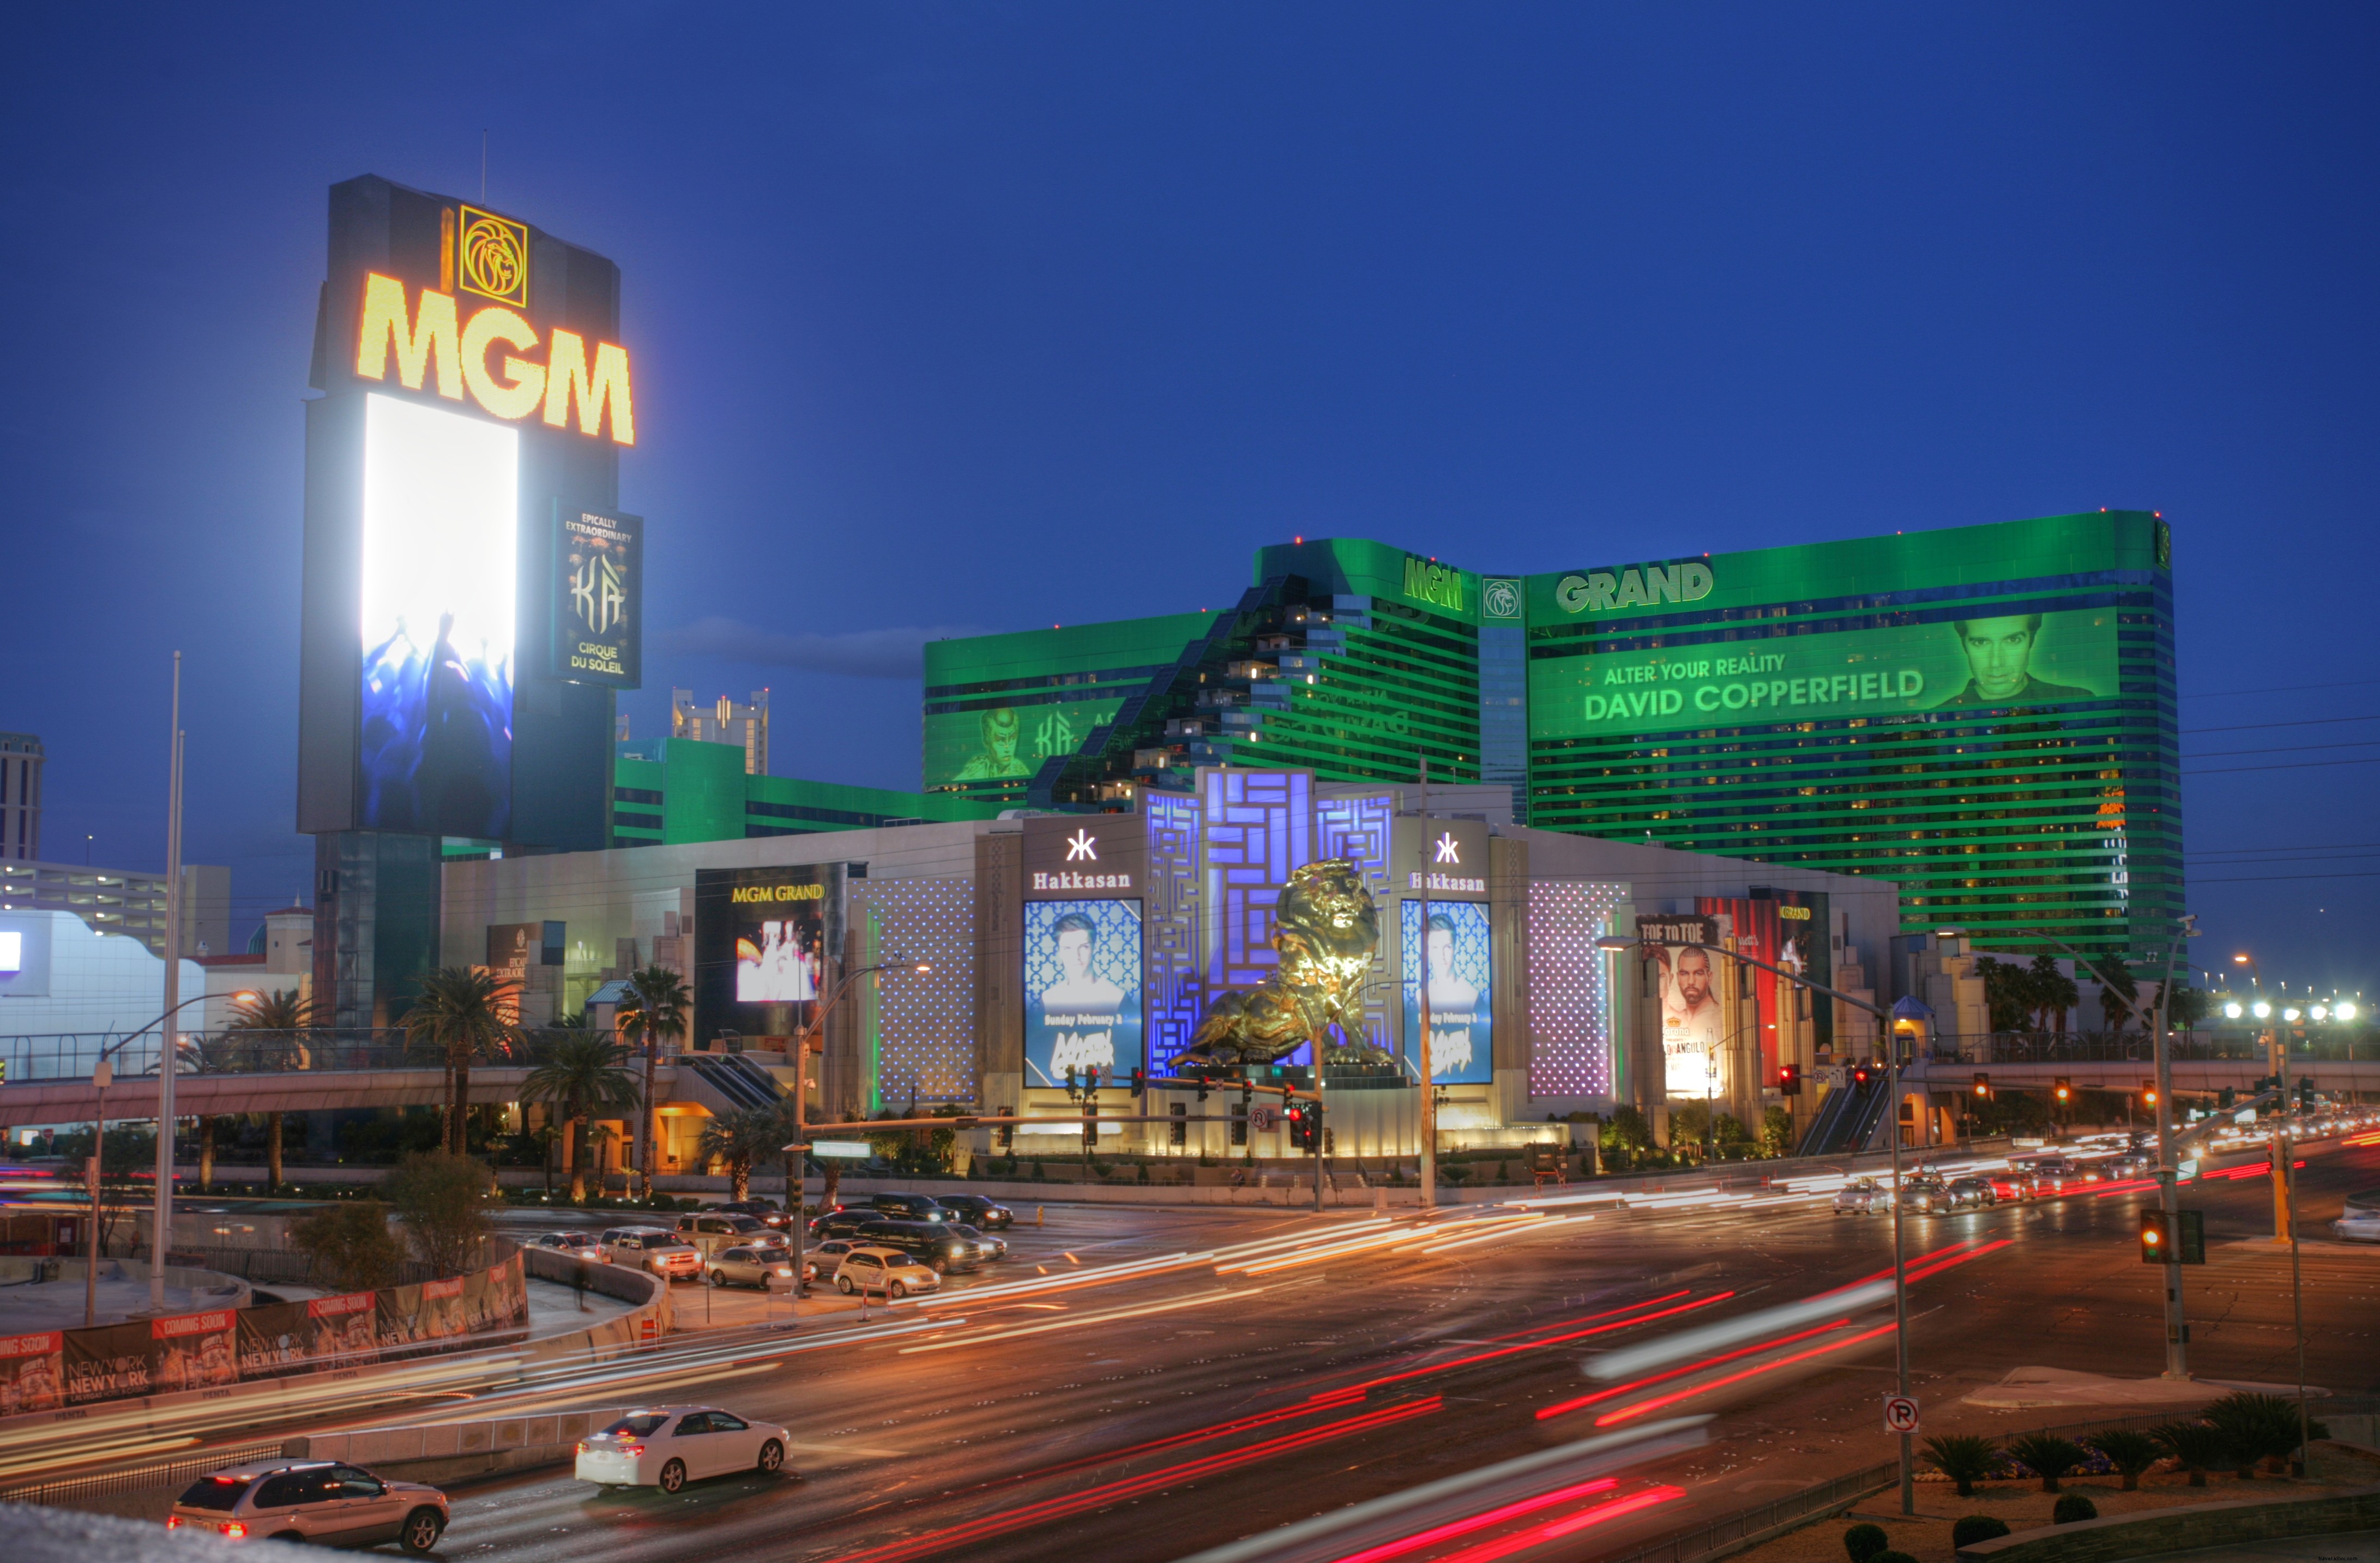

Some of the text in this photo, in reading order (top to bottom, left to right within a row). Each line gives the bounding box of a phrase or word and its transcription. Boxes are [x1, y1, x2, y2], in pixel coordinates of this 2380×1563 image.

[357, 272, 634, 445] MGM
[582, 513, 617, 529] EPICALLY
[566, 521, 632, 543] EXTRAORDINARY
[1404, 557, 1713, 613] MGM GRAND
[579, 642, 617, 660] CIRQUE
[571, 656, 624, 674] DU SOLEIL
[1604, 654, 1786, 685] ALTER YOUR REALITY
[1586, 670, 1924, 720] DAVID COPPERFIELD
[1034, 872, 1130, 889] Hakkasan
[732, 883, 826, 903] MGM GRAND
[1785, 906, 1811, 920] GRAND
[1641, 923, 1704, 945] TOE TO TOE
[1044, 1014, 1075, 1027] Sunday
[1077, 1014, 1114, 1026] February
[1443, 1012, 1471, 1025] February
[1677, 1042, 1704, 1054] ANGULO
[317, 1295, 367, 1314] COMING SOON
[165, 1313, 225, 1334] COMING SOON
[21, 1336, 50, 1352] SOON
[333, 1371, 358, 1380] PENTA
[70, 1394, 82, 1402] LAS
[82, 1392, 103, 1400] VEGAS
[126, 1385, 149, 1394] CASINO
[202, 1389, 231, 1399] PENTA
[56, 1410, 87, 1421] PENTA
